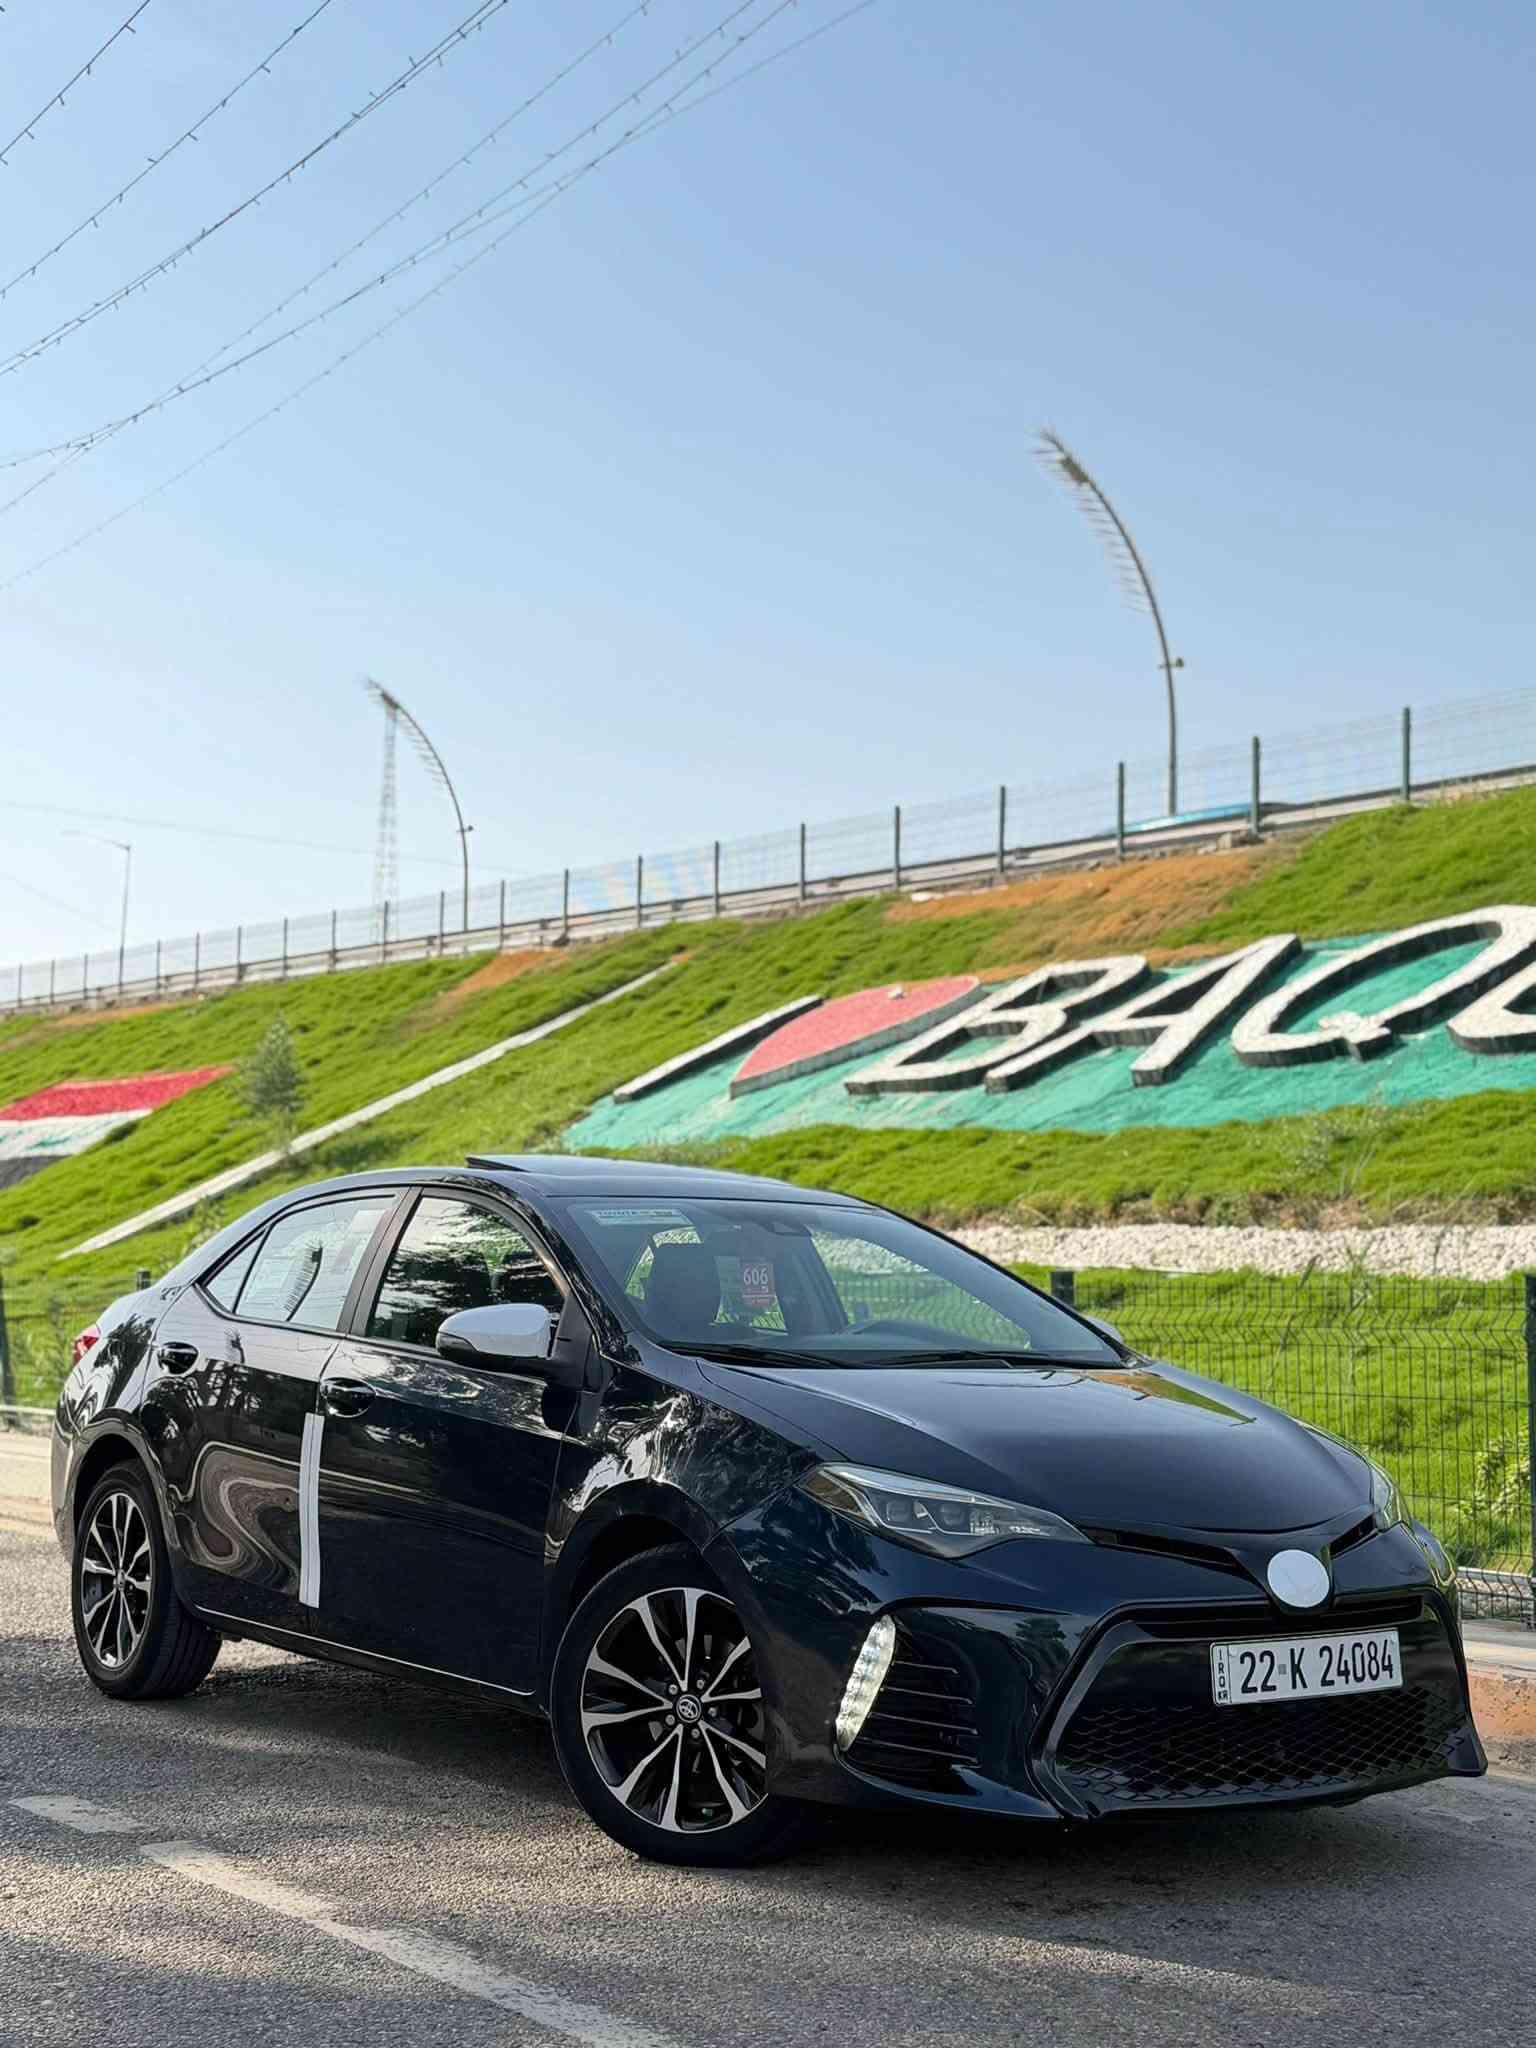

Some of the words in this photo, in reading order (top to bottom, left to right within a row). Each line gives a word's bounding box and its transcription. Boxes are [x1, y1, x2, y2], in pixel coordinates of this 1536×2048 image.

[1240, 1649, 1277, 1694] 22
[1290, 1647, 1308, 1690] K
[1319, 1639, 1393, 1687] 24084
